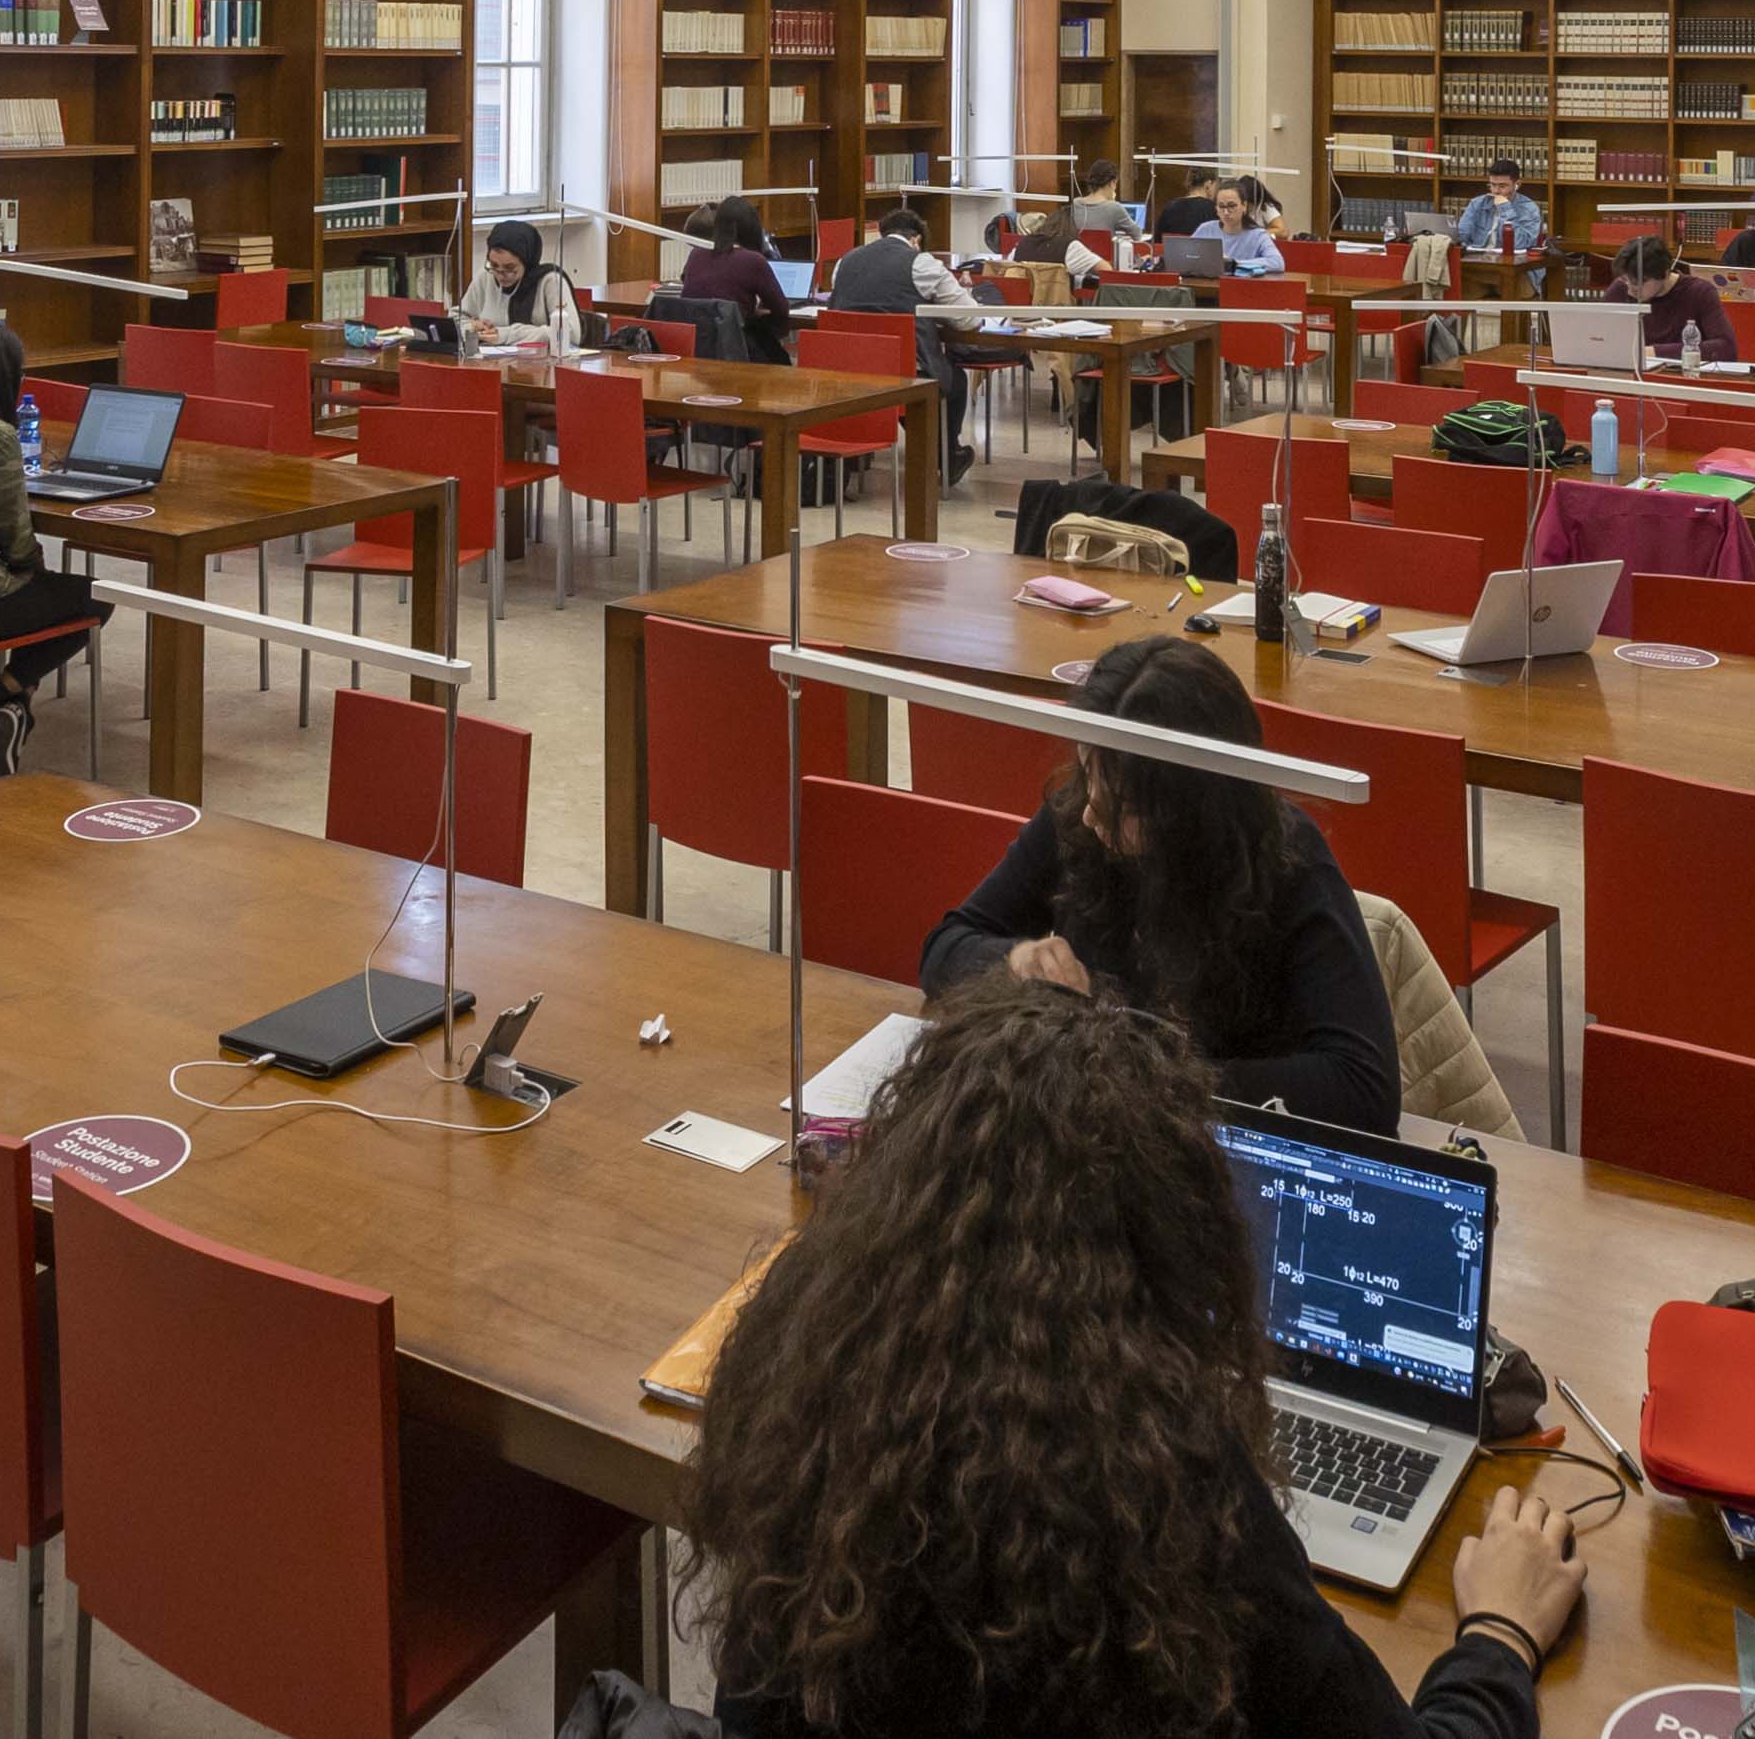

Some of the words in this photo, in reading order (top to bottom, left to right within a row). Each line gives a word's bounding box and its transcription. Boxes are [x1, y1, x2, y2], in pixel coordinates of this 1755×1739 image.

[66, 1127, 161, 1168] Postazione
[54, 1138, 135, 1175] Studente
[1260, 1184, 1274, 1198] 20
[1274, 1178, 1285, 1191] 15
[1320, 1189, 1353, 1208] L=250
[1307, 1202, 1326, 1216] 180
[1361, 1211, 1376, 1225] 20
[1277, 1261, 1291, 1275] 20
[1290, 1270, 1305, 1285] 20
[1366, 1273, 1400, 1291] L=470
[1363, 1291, 1384, 1307] 390
[1457, 1317, 1472, 1331] 20
